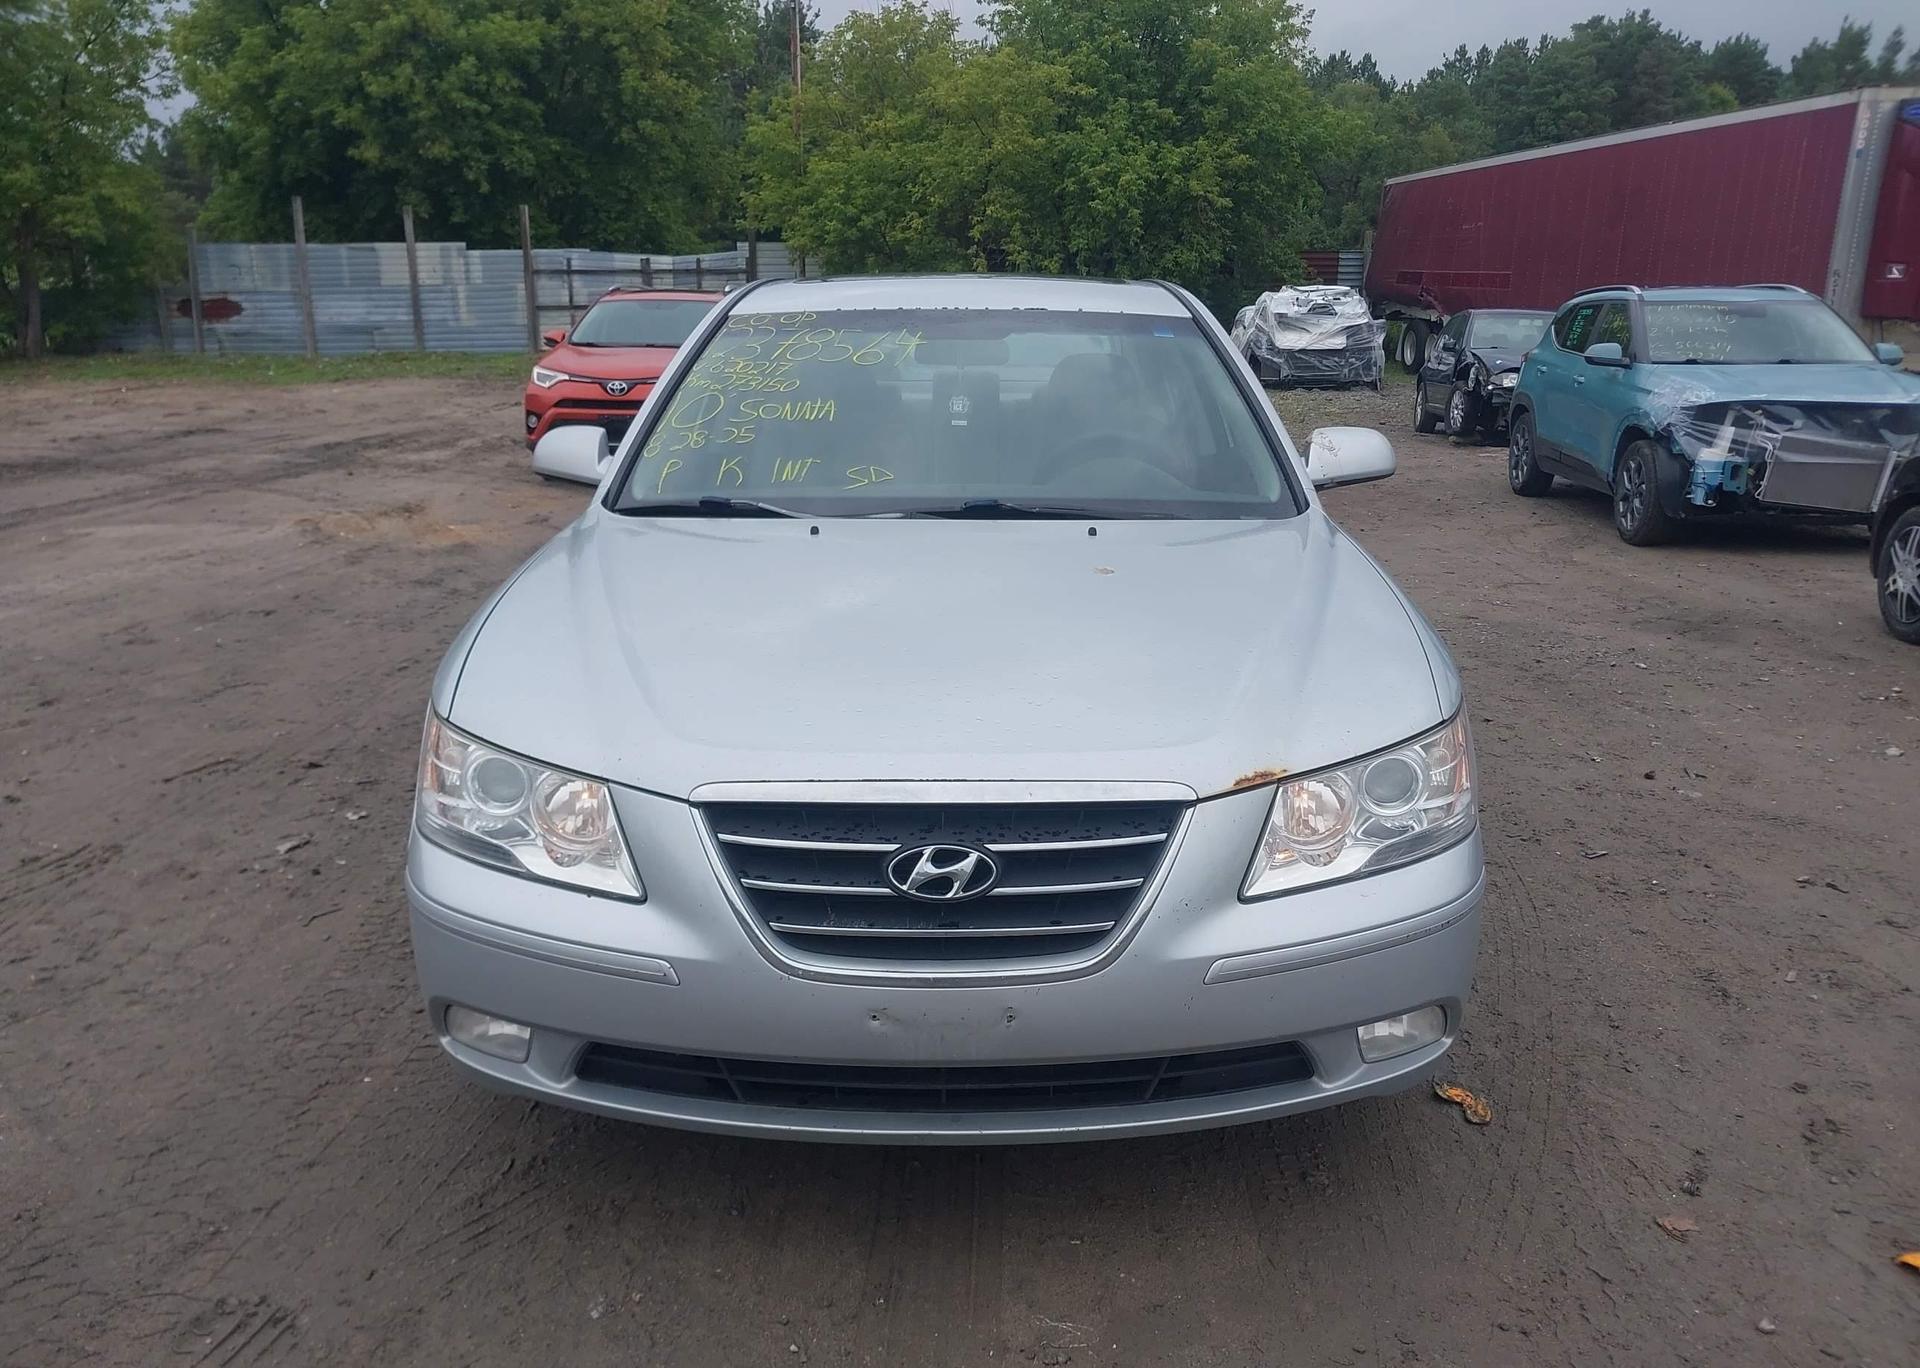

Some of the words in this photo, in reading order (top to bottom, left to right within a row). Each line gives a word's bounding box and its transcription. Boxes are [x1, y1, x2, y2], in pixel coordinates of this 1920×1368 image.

[657, 459, 683, 494] P
[715, 456, 744, 487] K
[770, 457, 821, 484] INT
